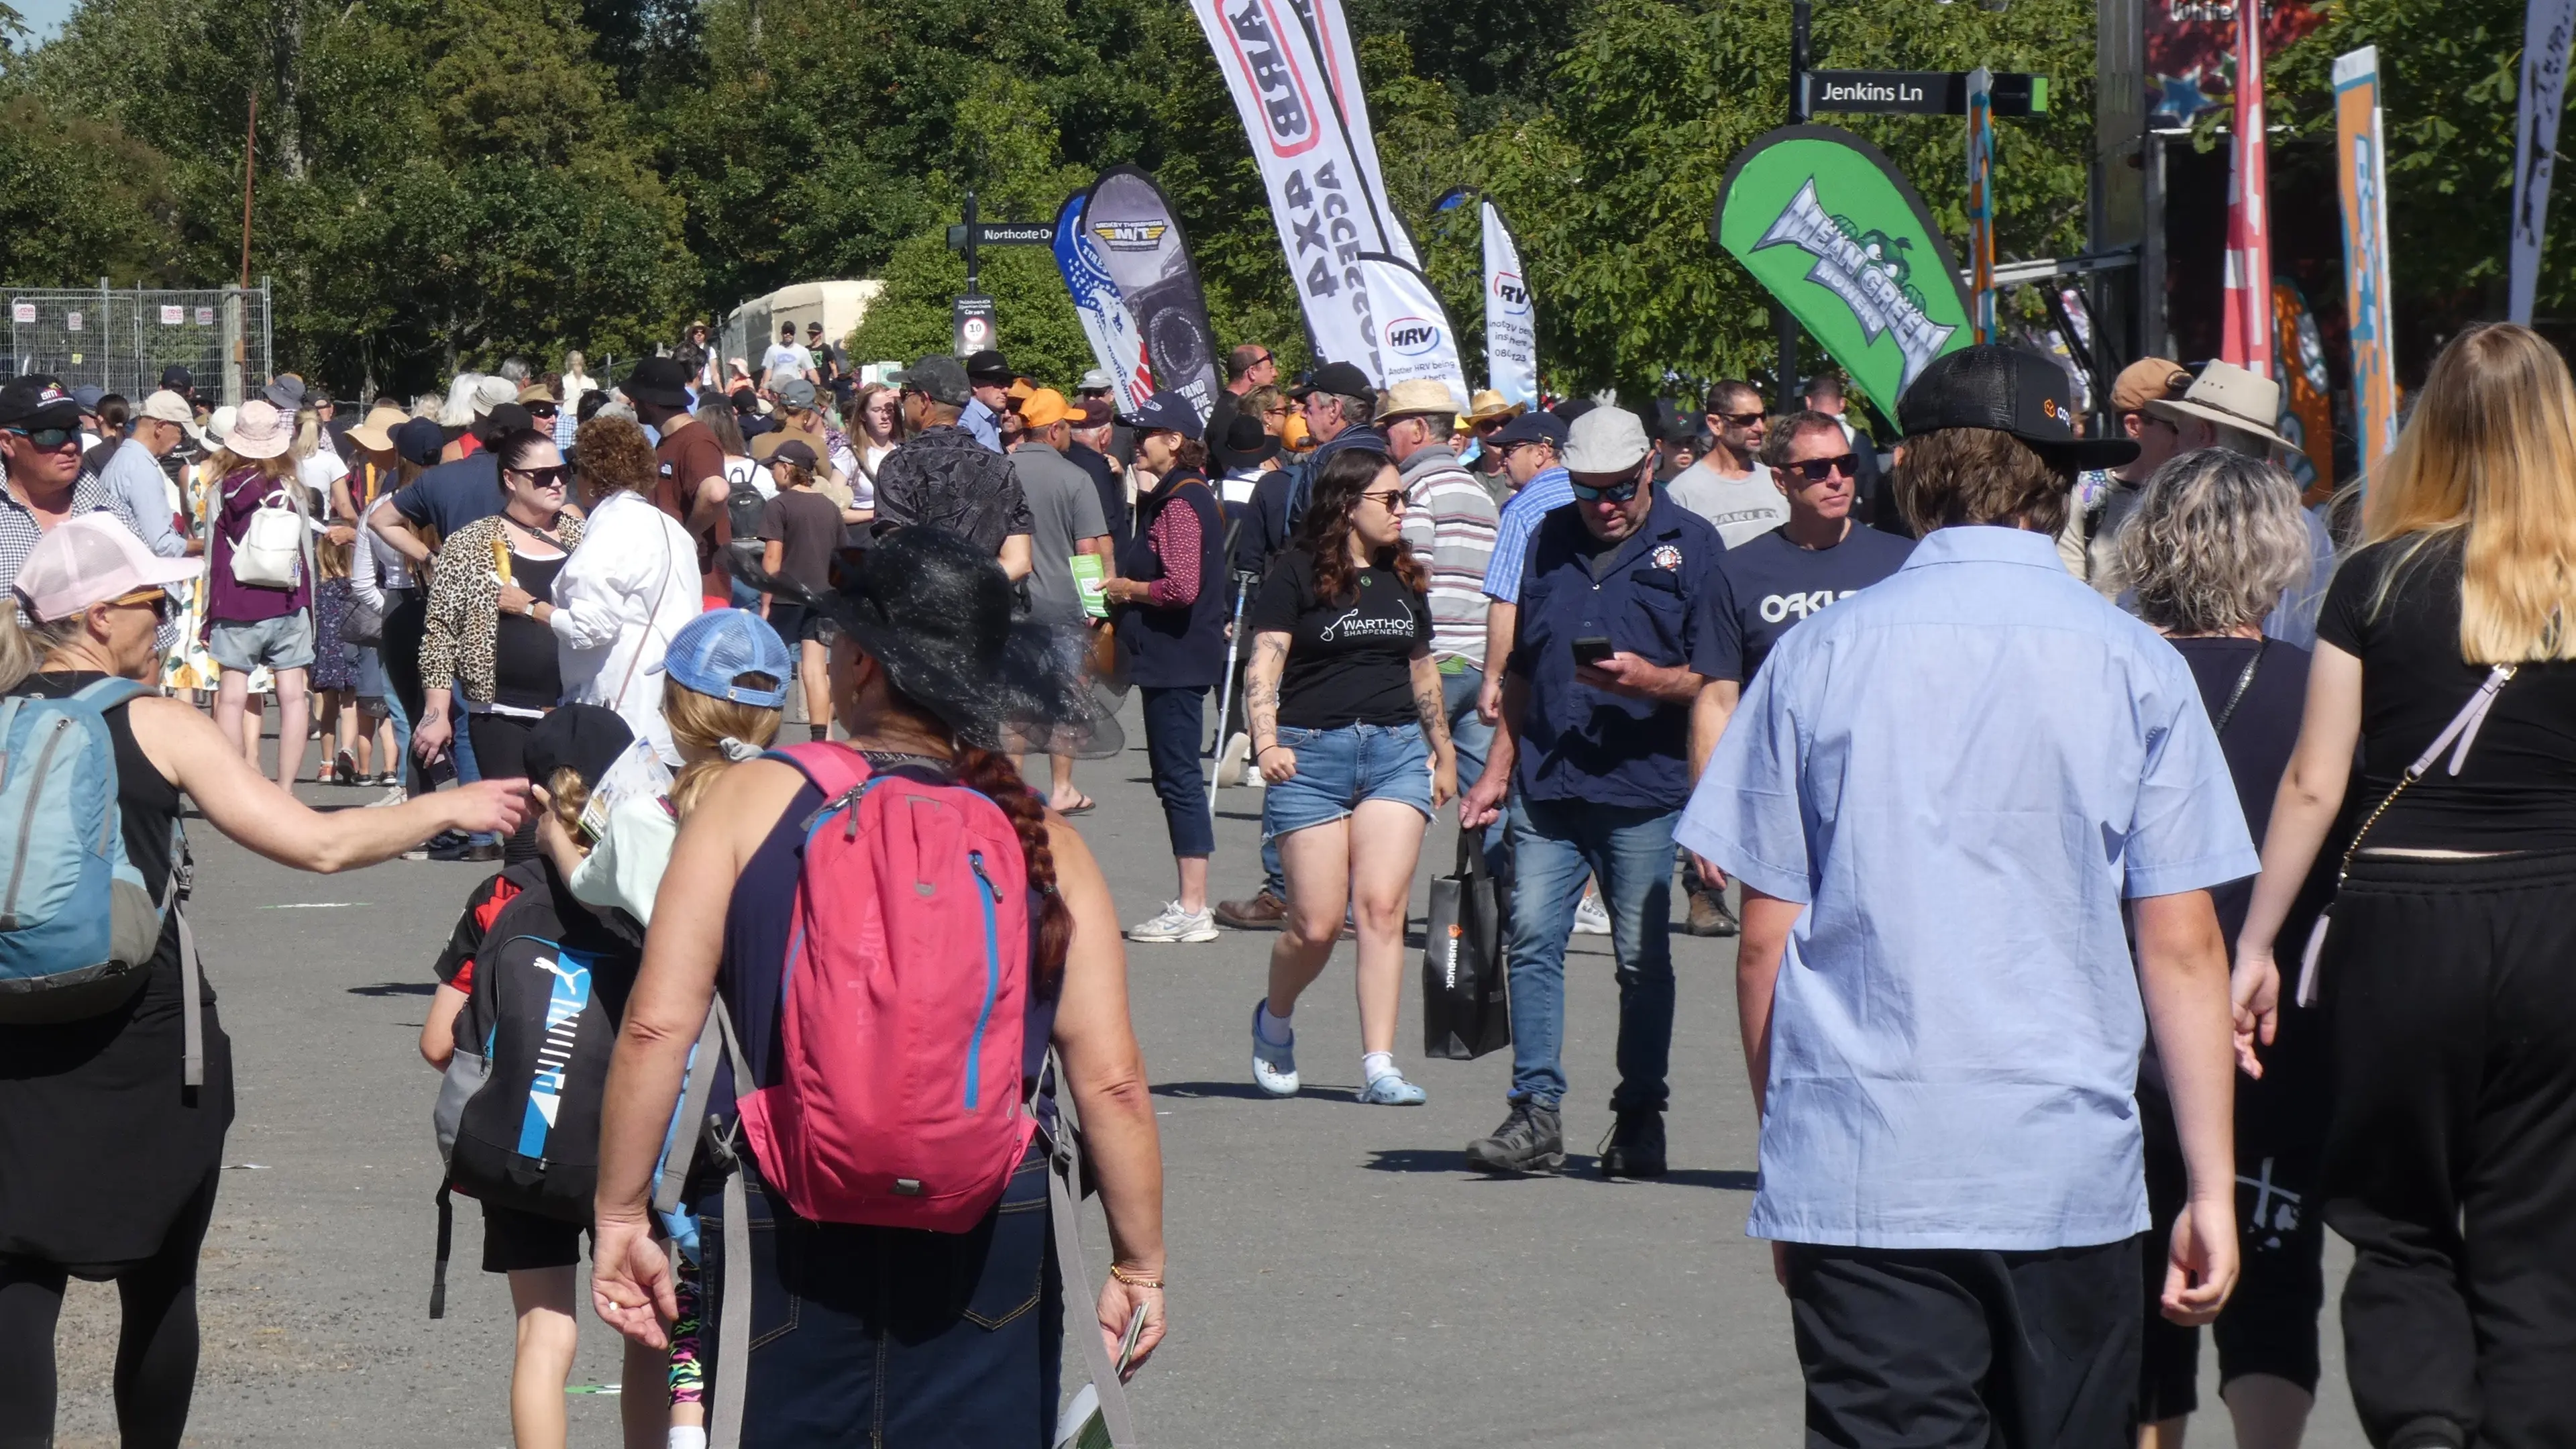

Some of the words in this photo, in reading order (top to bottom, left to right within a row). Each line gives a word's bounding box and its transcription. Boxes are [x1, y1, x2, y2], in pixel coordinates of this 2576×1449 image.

[1821, 82, 1896, 101] Jenkins
[1900, 83, 1923, 101] Ln
[984, 229, 1039, 240] Northcote
[1114, 227, 1150, 241] M/T
[1500, 284, 1527, 305] RV
[1748, 178, 1865, 276] MEAN
[1860, 265, 1956, 402] GREEN
[1815, 263, 1878, 333] MOWERS
[969, 323, 982, 333] 10
[1391, 326, 1434, 347] HRV
[1389, 366, 1413, 376] Another
[1414, 362, 1430, 372] HRV
[1432, 360, 1455, 370] being
[1175, 379, 1206, 399] TAND
[1343, 618, 1415, 631] WARTHOG
[1344, 629, 1404, 637] SHARPENERS
